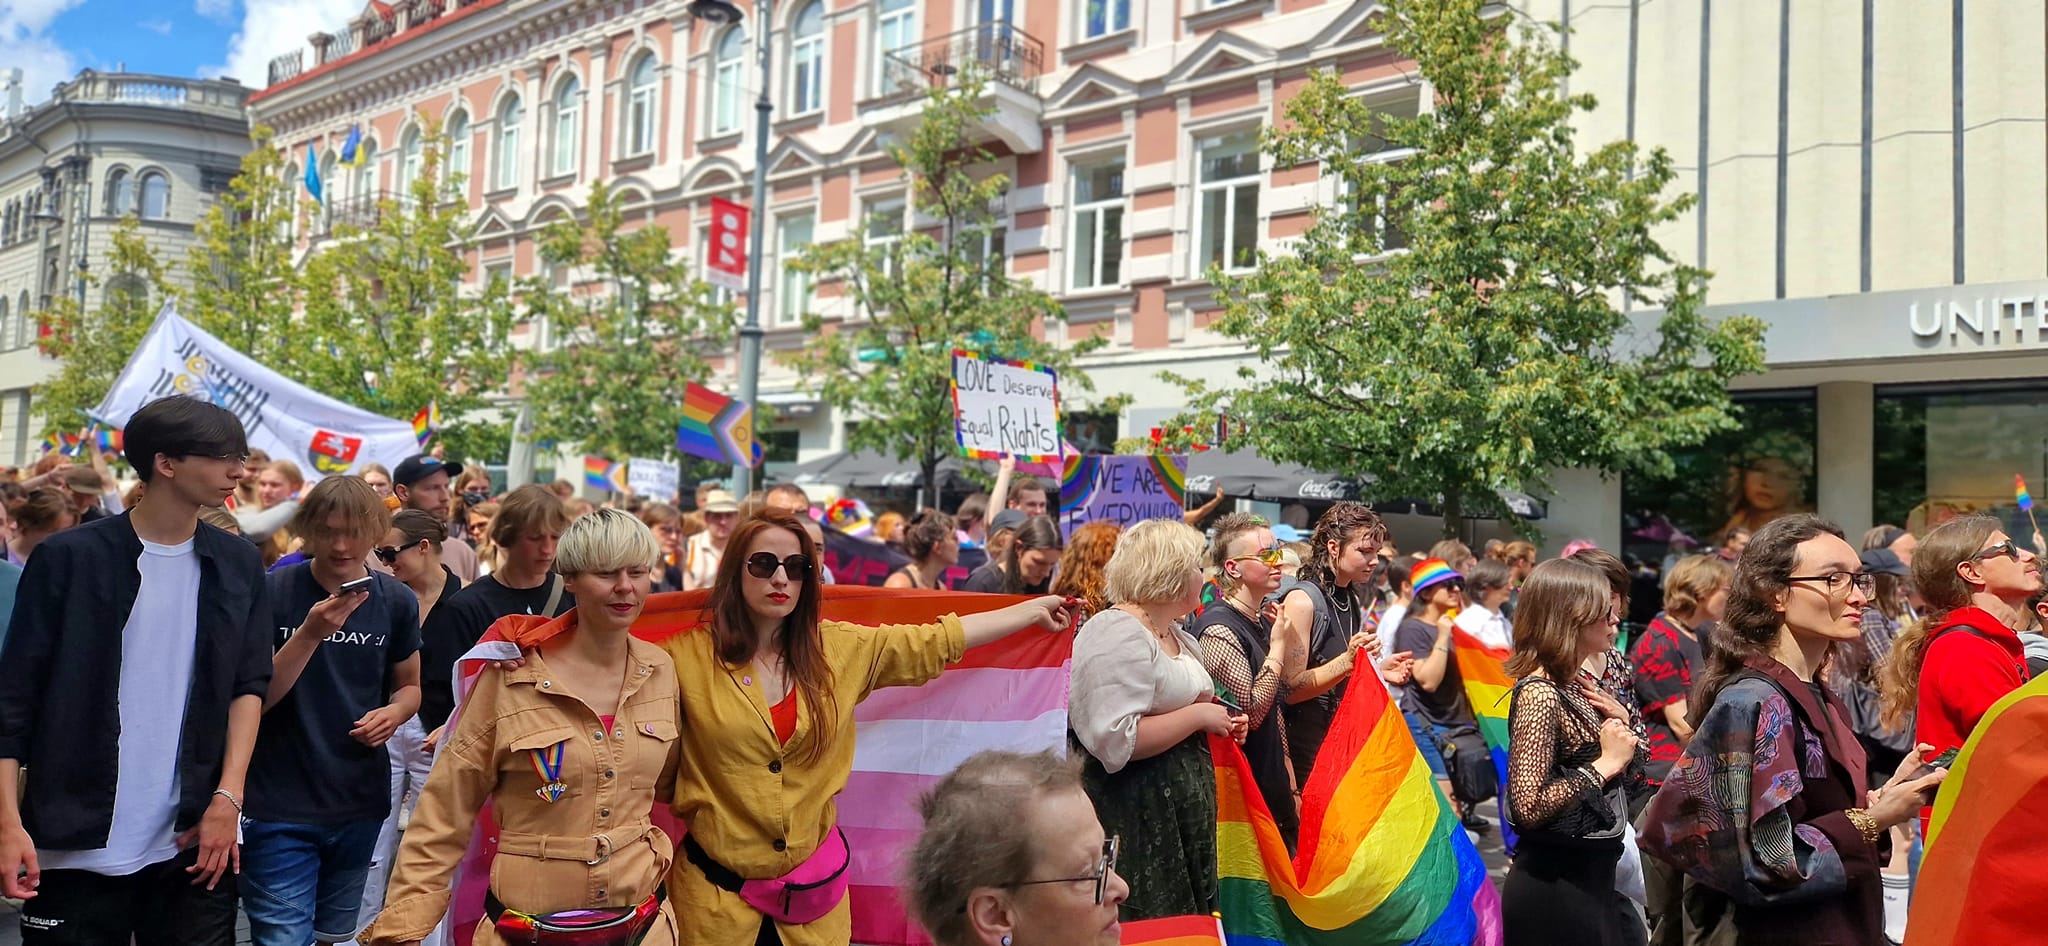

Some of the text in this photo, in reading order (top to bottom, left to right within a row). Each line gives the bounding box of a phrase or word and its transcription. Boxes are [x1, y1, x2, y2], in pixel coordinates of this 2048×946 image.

[956, 359, 996, 392] LOVE
[959, 404, 1055, 455] Equal Rights
[1089, 463, 1163, 496] WE ARE
[1298, 479, 1348, 499] Coca-Cola
